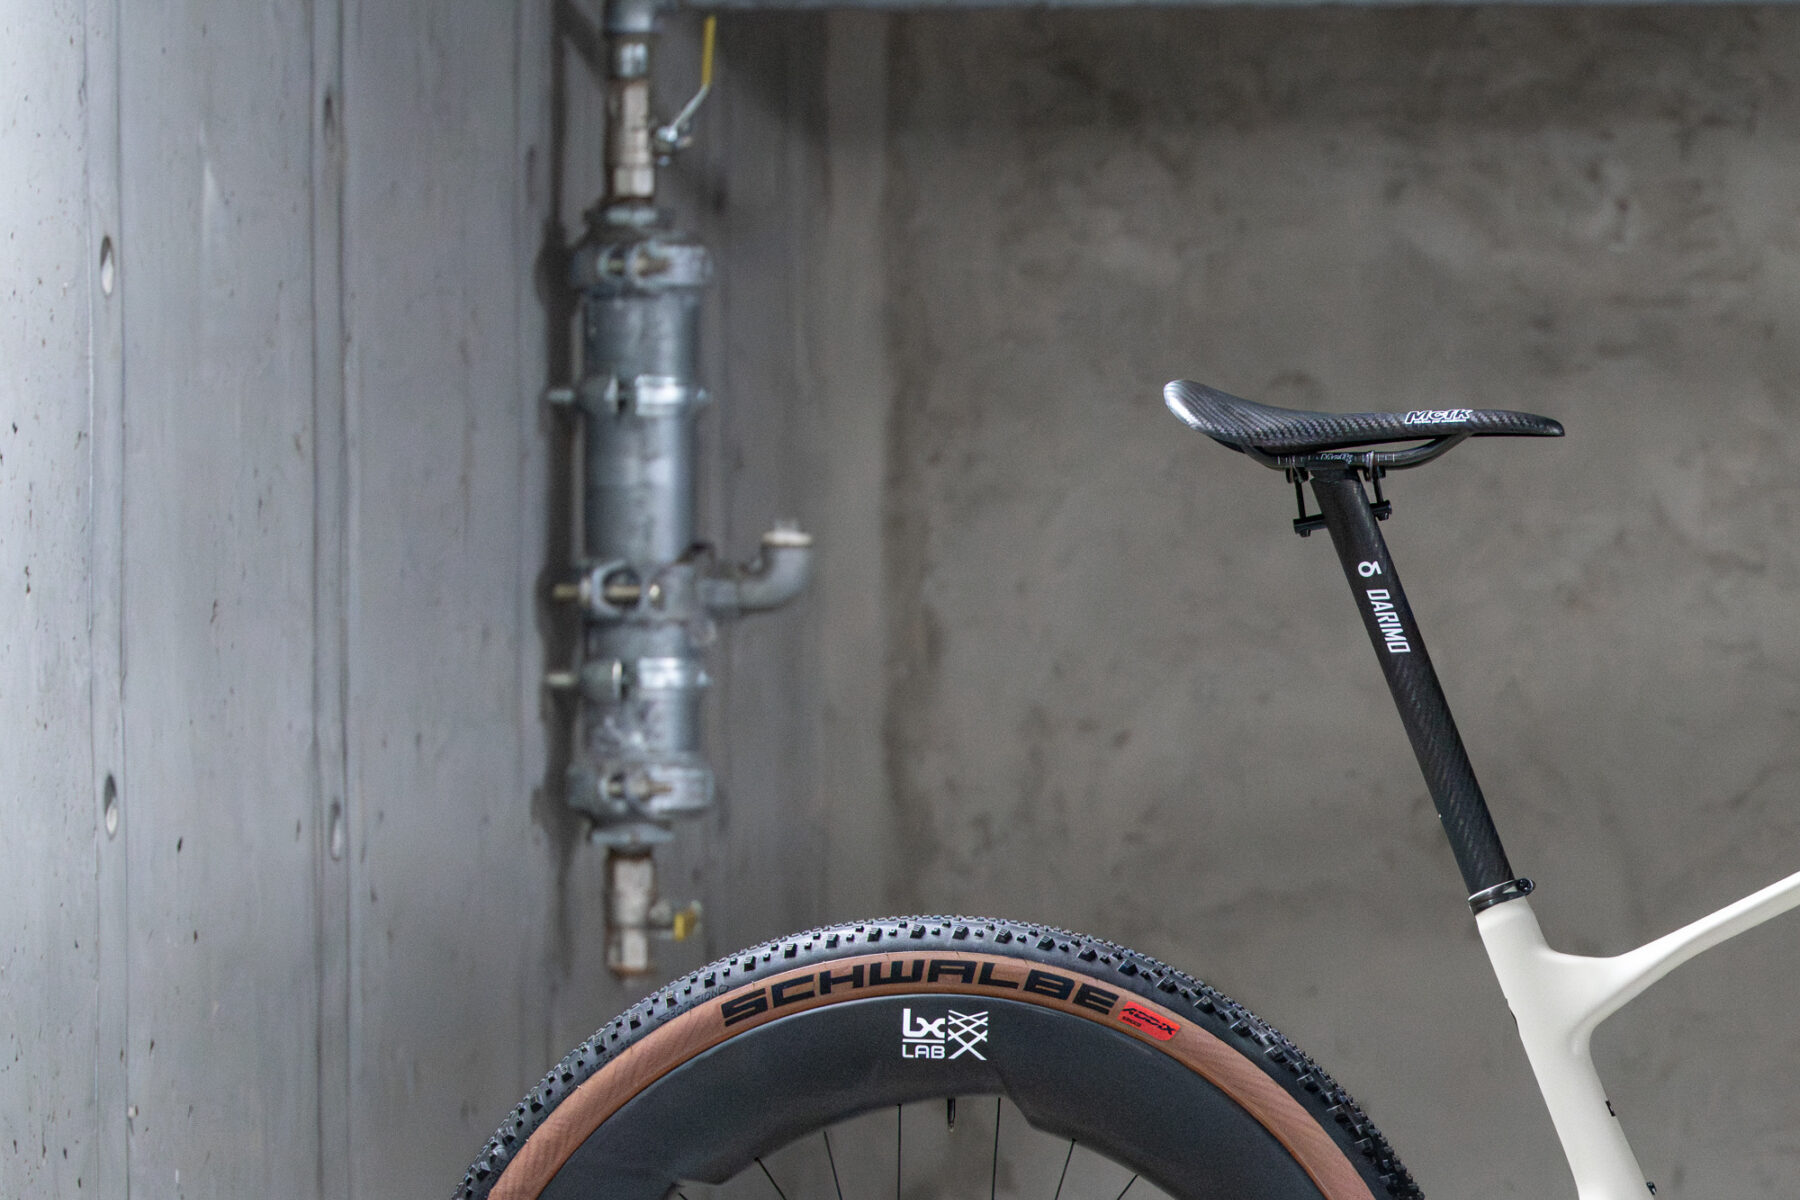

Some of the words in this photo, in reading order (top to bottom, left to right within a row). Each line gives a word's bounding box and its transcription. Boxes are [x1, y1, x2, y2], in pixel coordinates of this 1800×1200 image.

[1366, 588, 1411, 653] DARIMO
[720, 958, 1120, 1027] SCHWALBE
[902, 1045, 946, 1059] LAB
